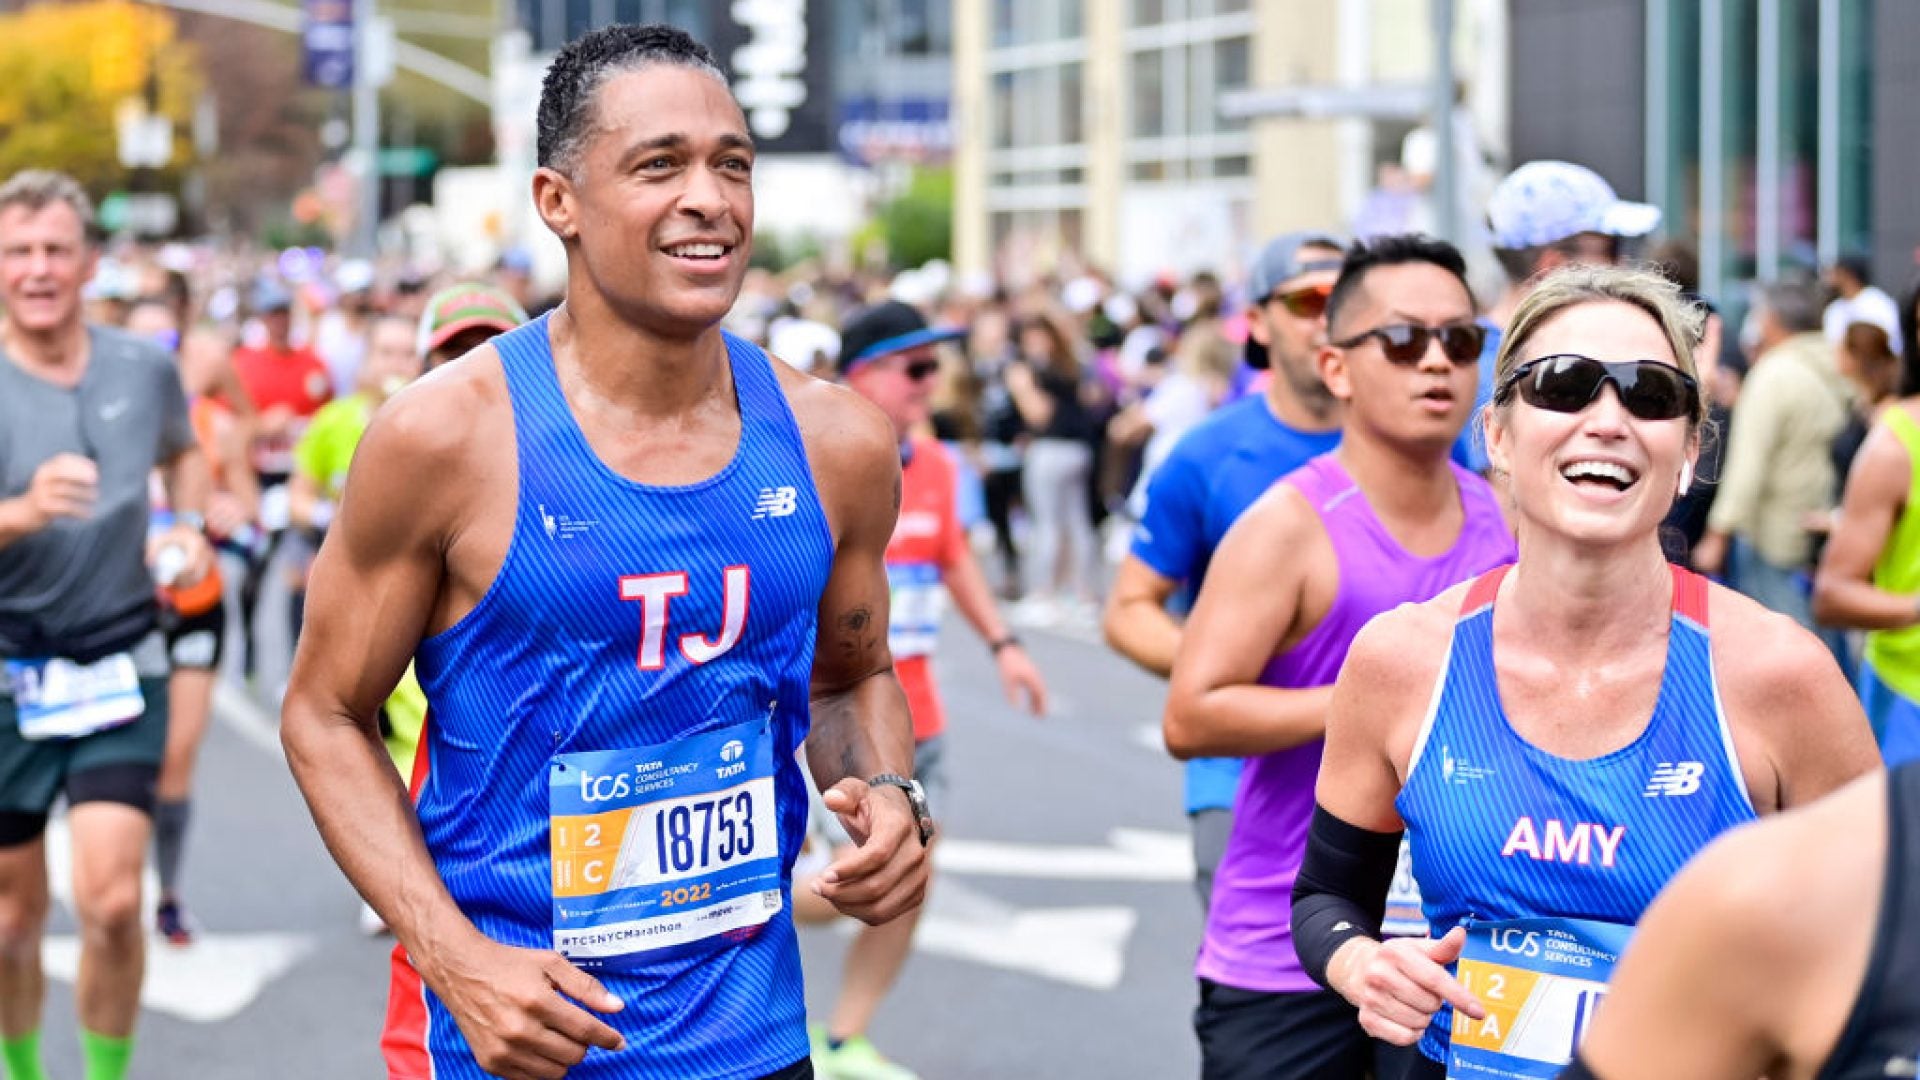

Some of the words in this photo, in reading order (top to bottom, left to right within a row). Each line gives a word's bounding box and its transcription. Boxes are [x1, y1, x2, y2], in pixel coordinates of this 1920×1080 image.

[618, 564, 750, 671] TJ
[635, 761, 663, 772] TATA
[716, 761, 747, 779] TATA
[580, 770, 631, 802] tcs
[584, 823, 601, 847] 2
[655, 790, 755, 875] 18753
[1501, 816, 1627, 868] AMY
[583, 860, 604, 884] C
[661, 882, 712, 907] 2022
[1486, 974, 1505, 1000] 2
[1479, 1014, 1500, 1040] A
